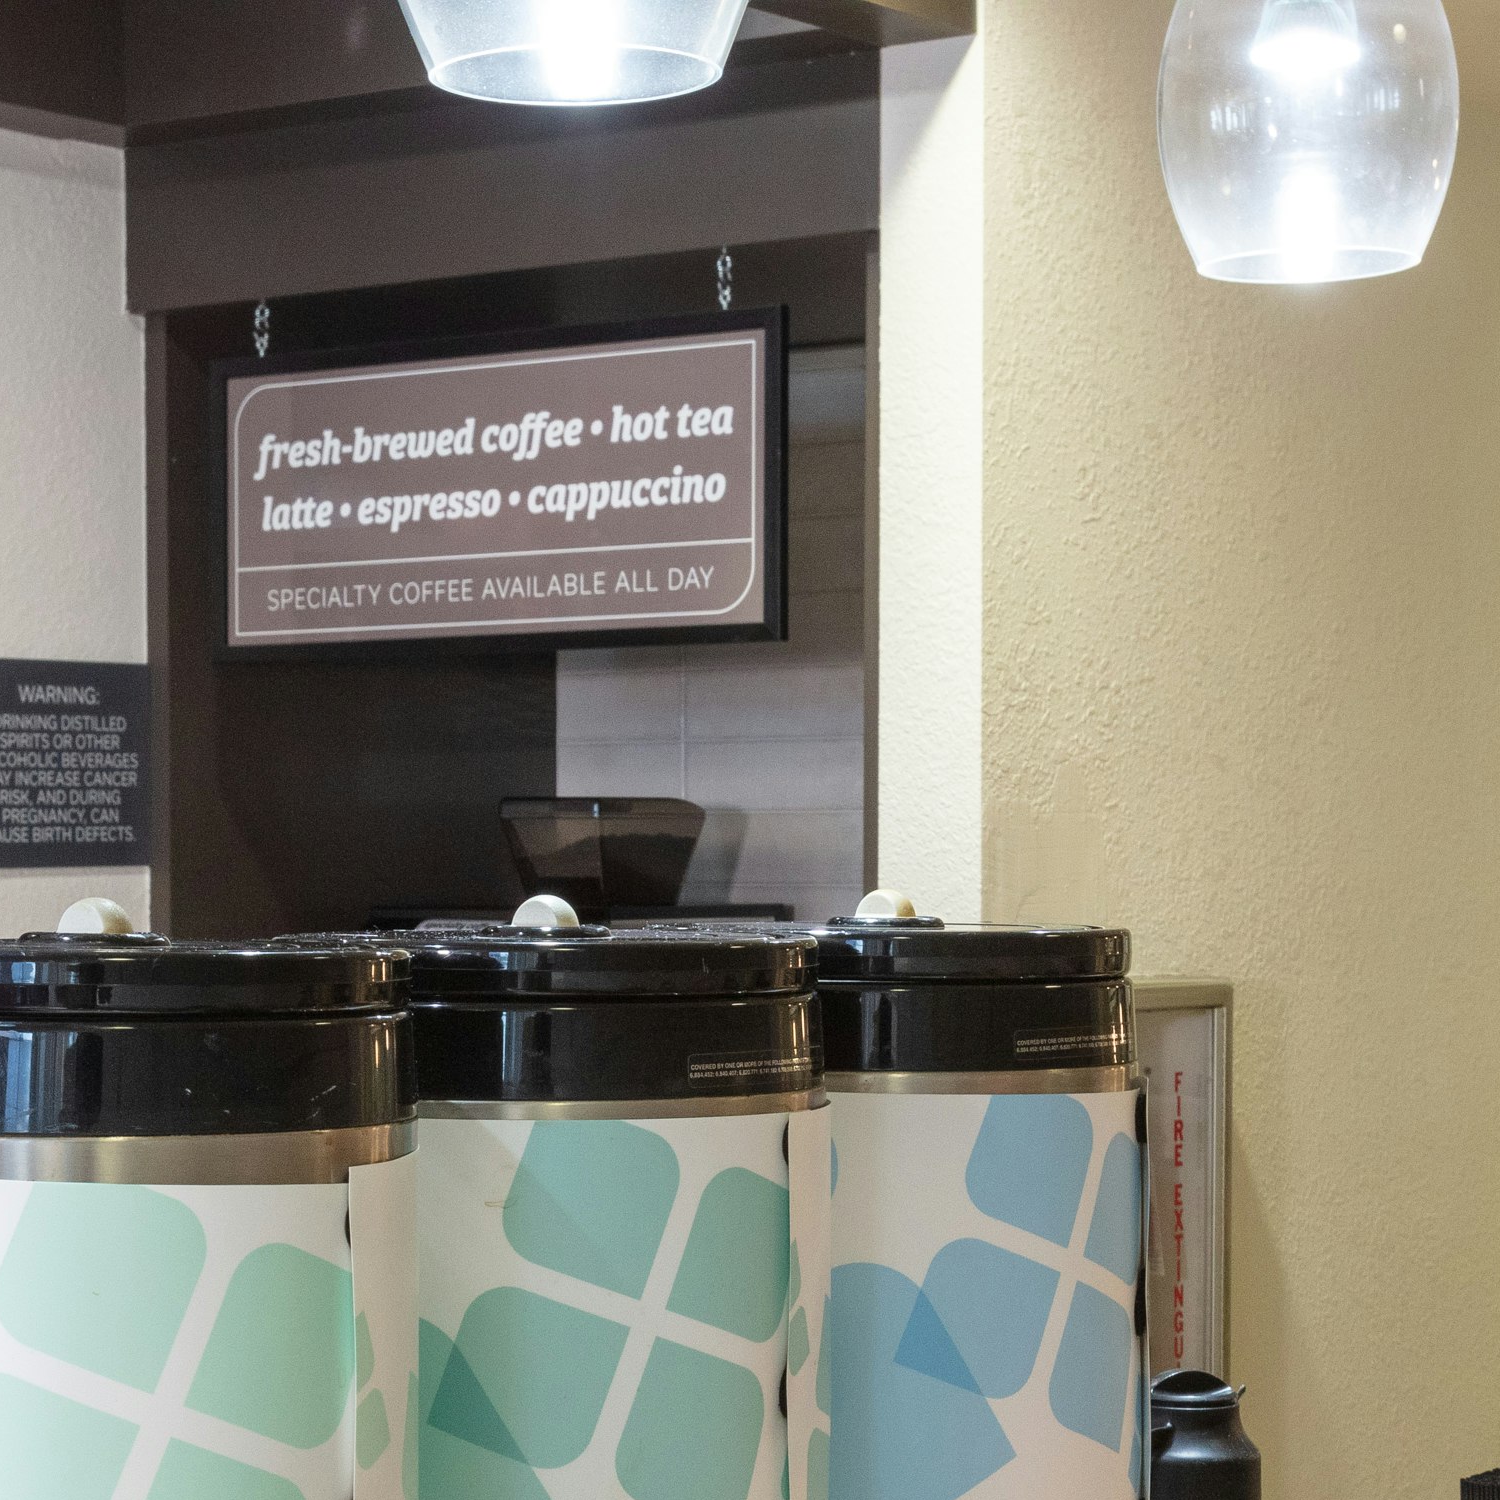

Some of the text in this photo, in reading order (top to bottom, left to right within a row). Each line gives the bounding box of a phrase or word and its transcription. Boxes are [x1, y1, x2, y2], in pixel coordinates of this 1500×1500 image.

[254, 404, 733, 481] fresh-brewed coffee hot tea
[262, 466, 727, 532] latte espresso cappuccino
[267, 565, 715, 612] SPECIALTY COFFEE AVAILABLE ALL DAY
[60, 715, 127, 732] DISTILLED
[0, 733, 120, 750] SPIRITS OR OTHER
[61, 752, 139, 769] BEVERAGES
[15, 771, 81, 787] INCREASE
[84, 771, 138, 787] CANCER
[37, 790, 67, 805] AND
[69, 790, 121, 805] DURING
[91, 808, 119, 823] CAN
[32, 826, 72, 842] BIRTH
[1174, 1071, 1184, 1167] FIRE
